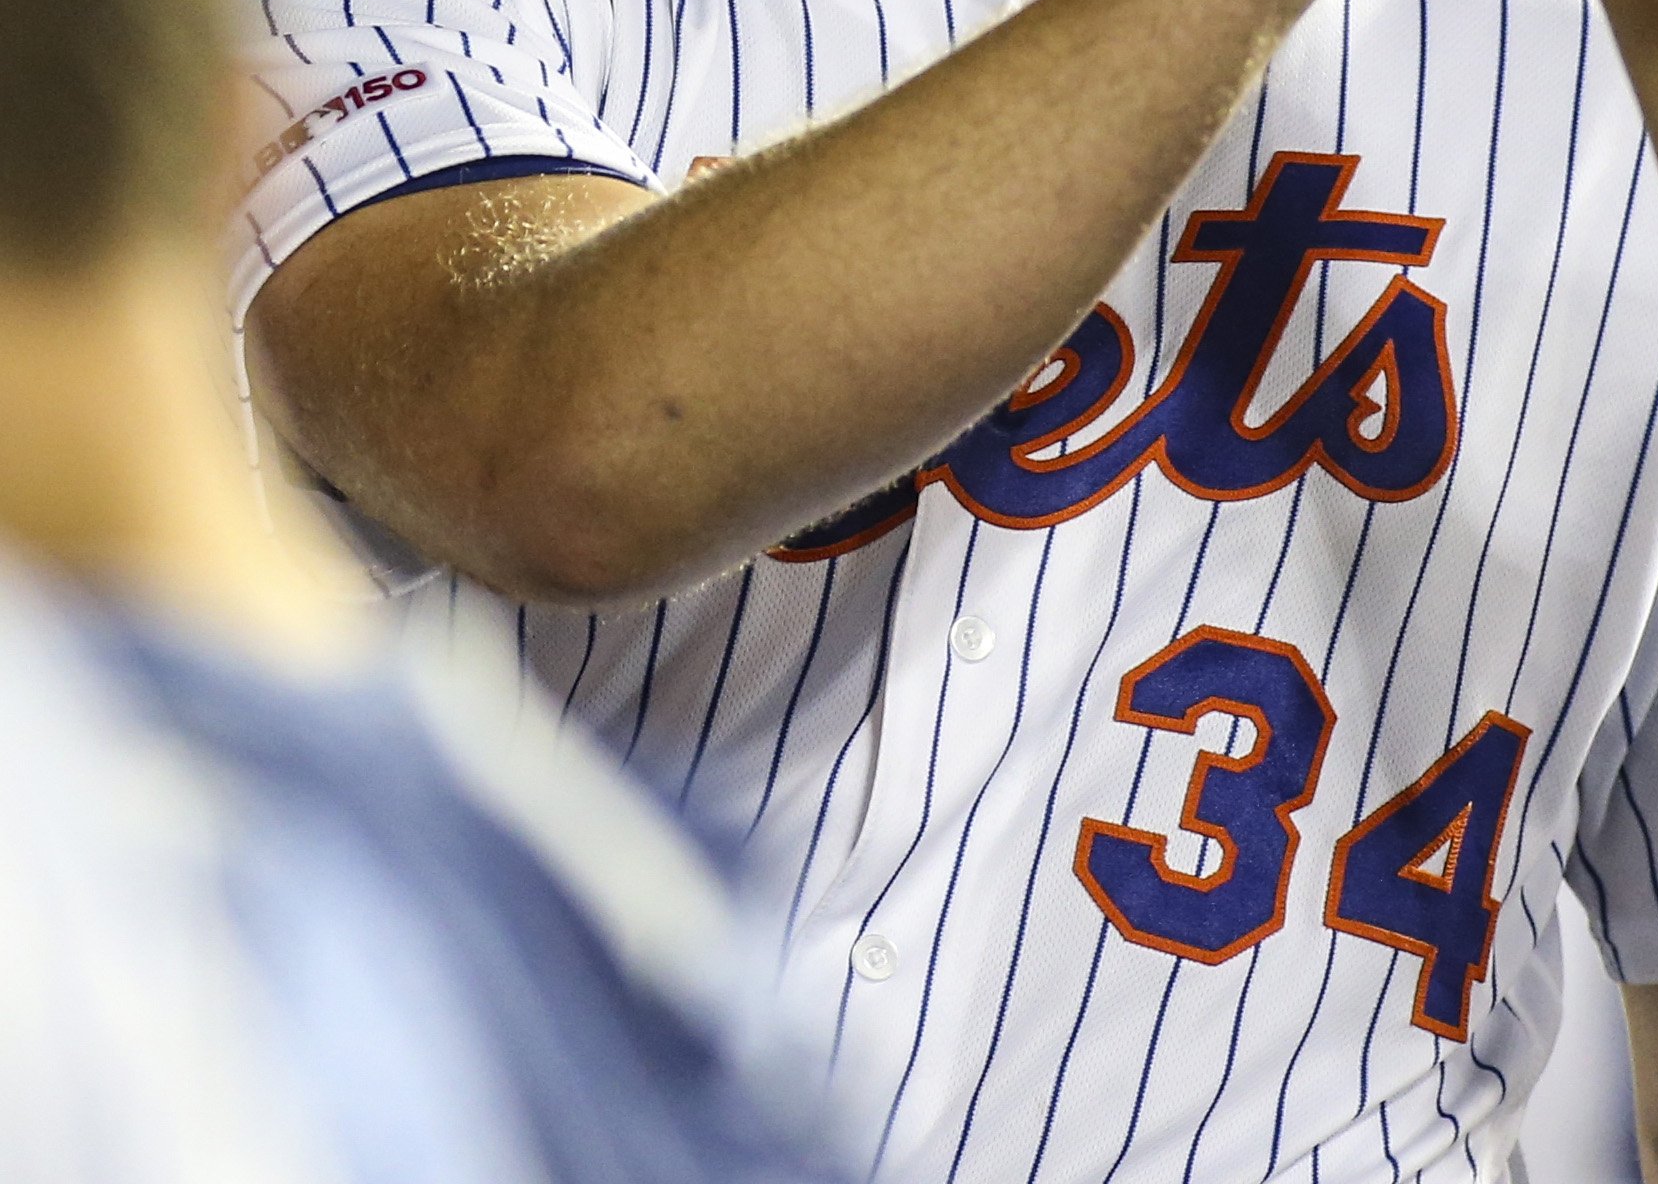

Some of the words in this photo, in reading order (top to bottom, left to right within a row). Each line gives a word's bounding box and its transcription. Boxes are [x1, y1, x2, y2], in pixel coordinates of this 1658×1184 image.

[344, 68, 428, 110] 150
[767, 151, 1459, 562] ets
[1072, 624, 1533, 1043] 34
